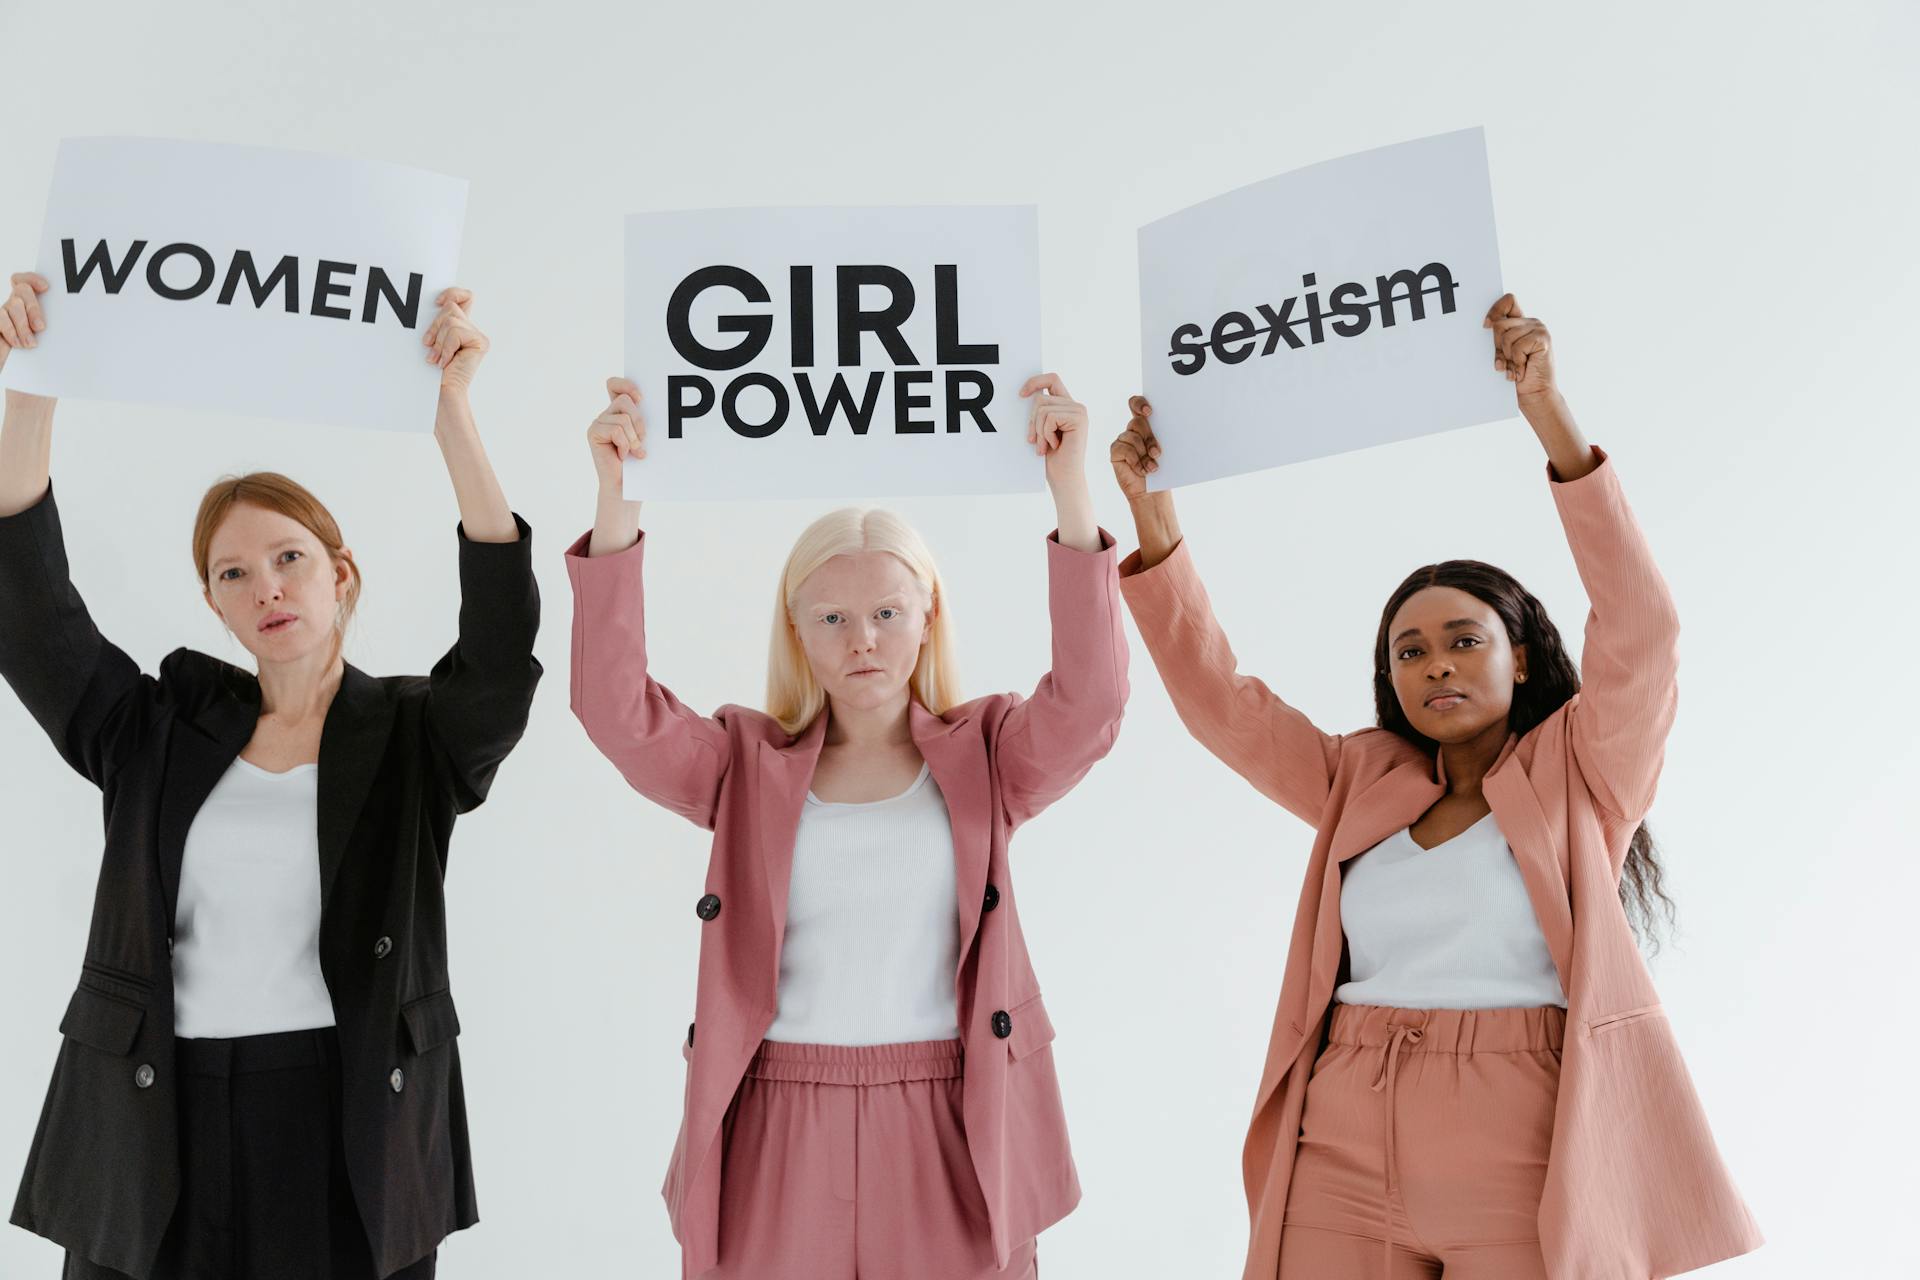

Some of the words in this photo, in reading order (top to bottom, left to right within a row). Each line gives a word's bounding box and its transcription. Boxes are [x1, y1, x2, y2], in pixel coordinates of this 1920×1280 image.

[61, 239, 424, 330] WOMEN
[667, 264, 1000, 370] GIRL
[1168, 262, 1460, 376] sexism
[667, 370, 998, 439] POWER
